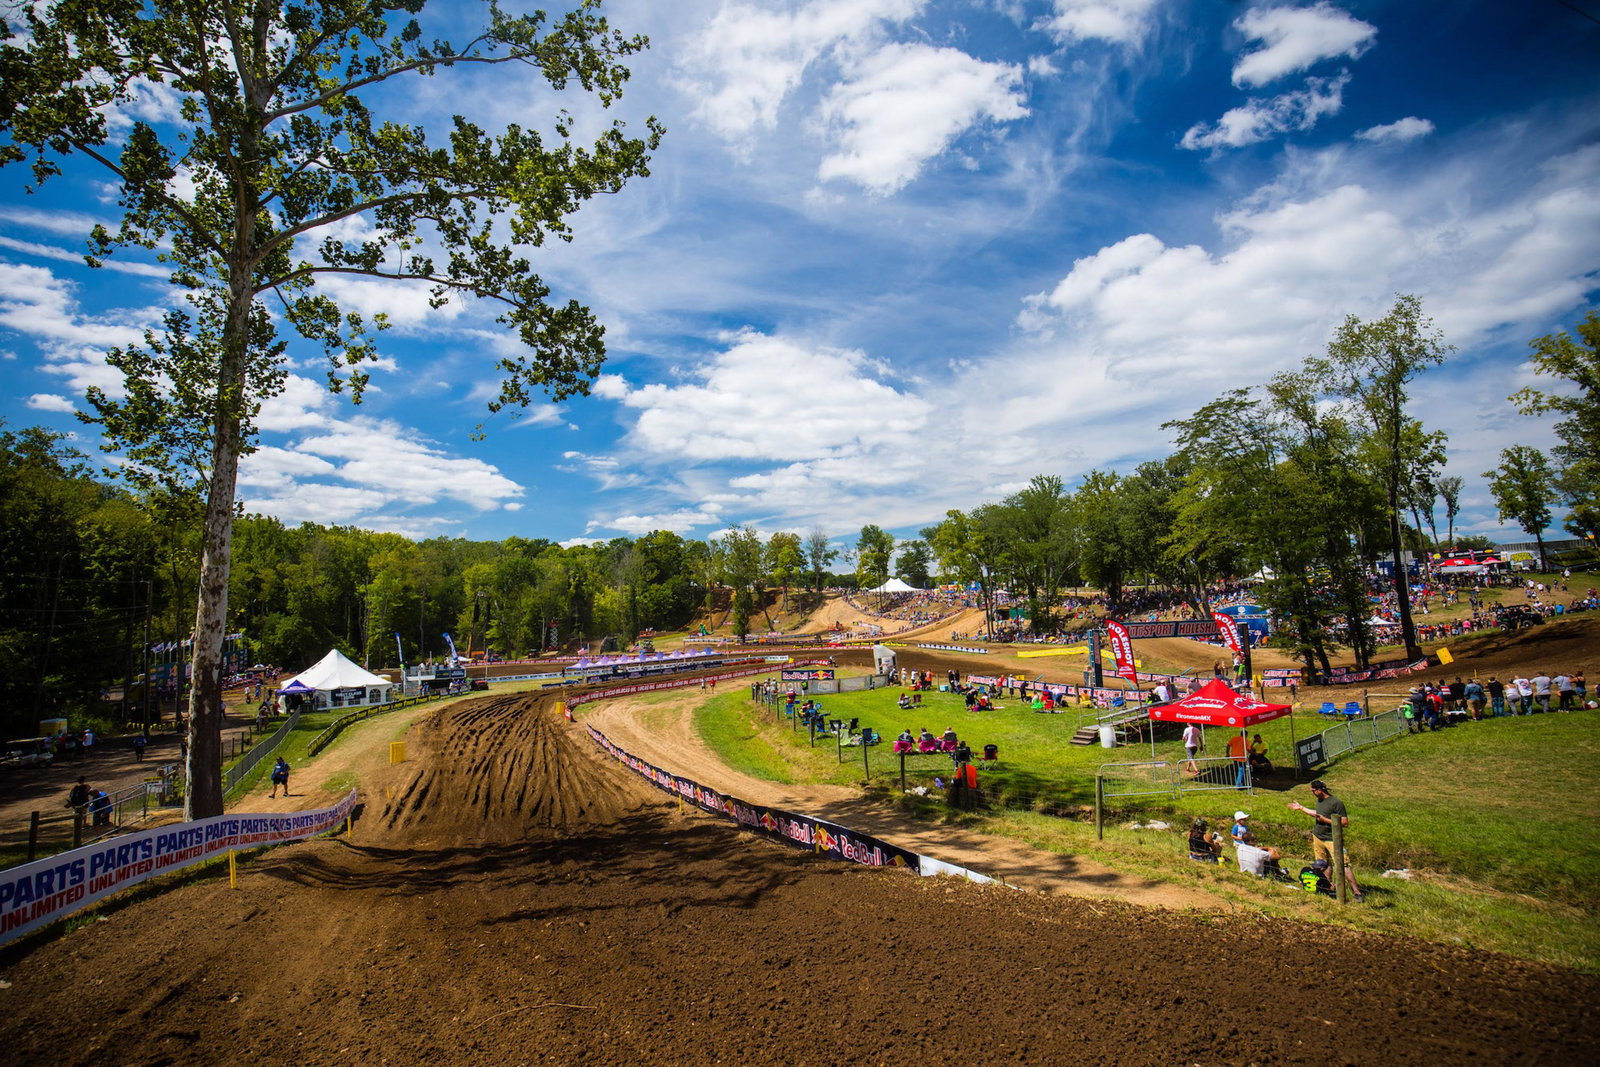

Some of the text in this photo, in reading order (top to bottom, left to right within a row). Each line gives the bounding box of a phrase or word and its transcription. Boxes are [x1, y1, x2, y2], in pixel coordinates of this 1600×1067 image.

[1179, 621, 1220, 635] HOLESHO
[1214, 614, 1242, 649] HOLESHOT
[1220, 626, 1233, 645] CLUB
[1108, 622, 1134, 666] HOLESHOT
[1111, 636, 1122, 659] CLUB
[0, 858, 85, 914] PARTS
[90, 837, 153, 878] PARTS
[156, 826, 203, 856] PARTS
[205, 820, 239, 842] PARTS
[240, 819, 269, 834] PARTS
[292, 815, 314, 829] PARTS
[89, 857, 154, 895] UNLIMITED
[155, 845, 203, 870] UNLIMITED
[240, 832, 268, 845] UNLIMITED
[1303, 879, 1317, 892] 3
